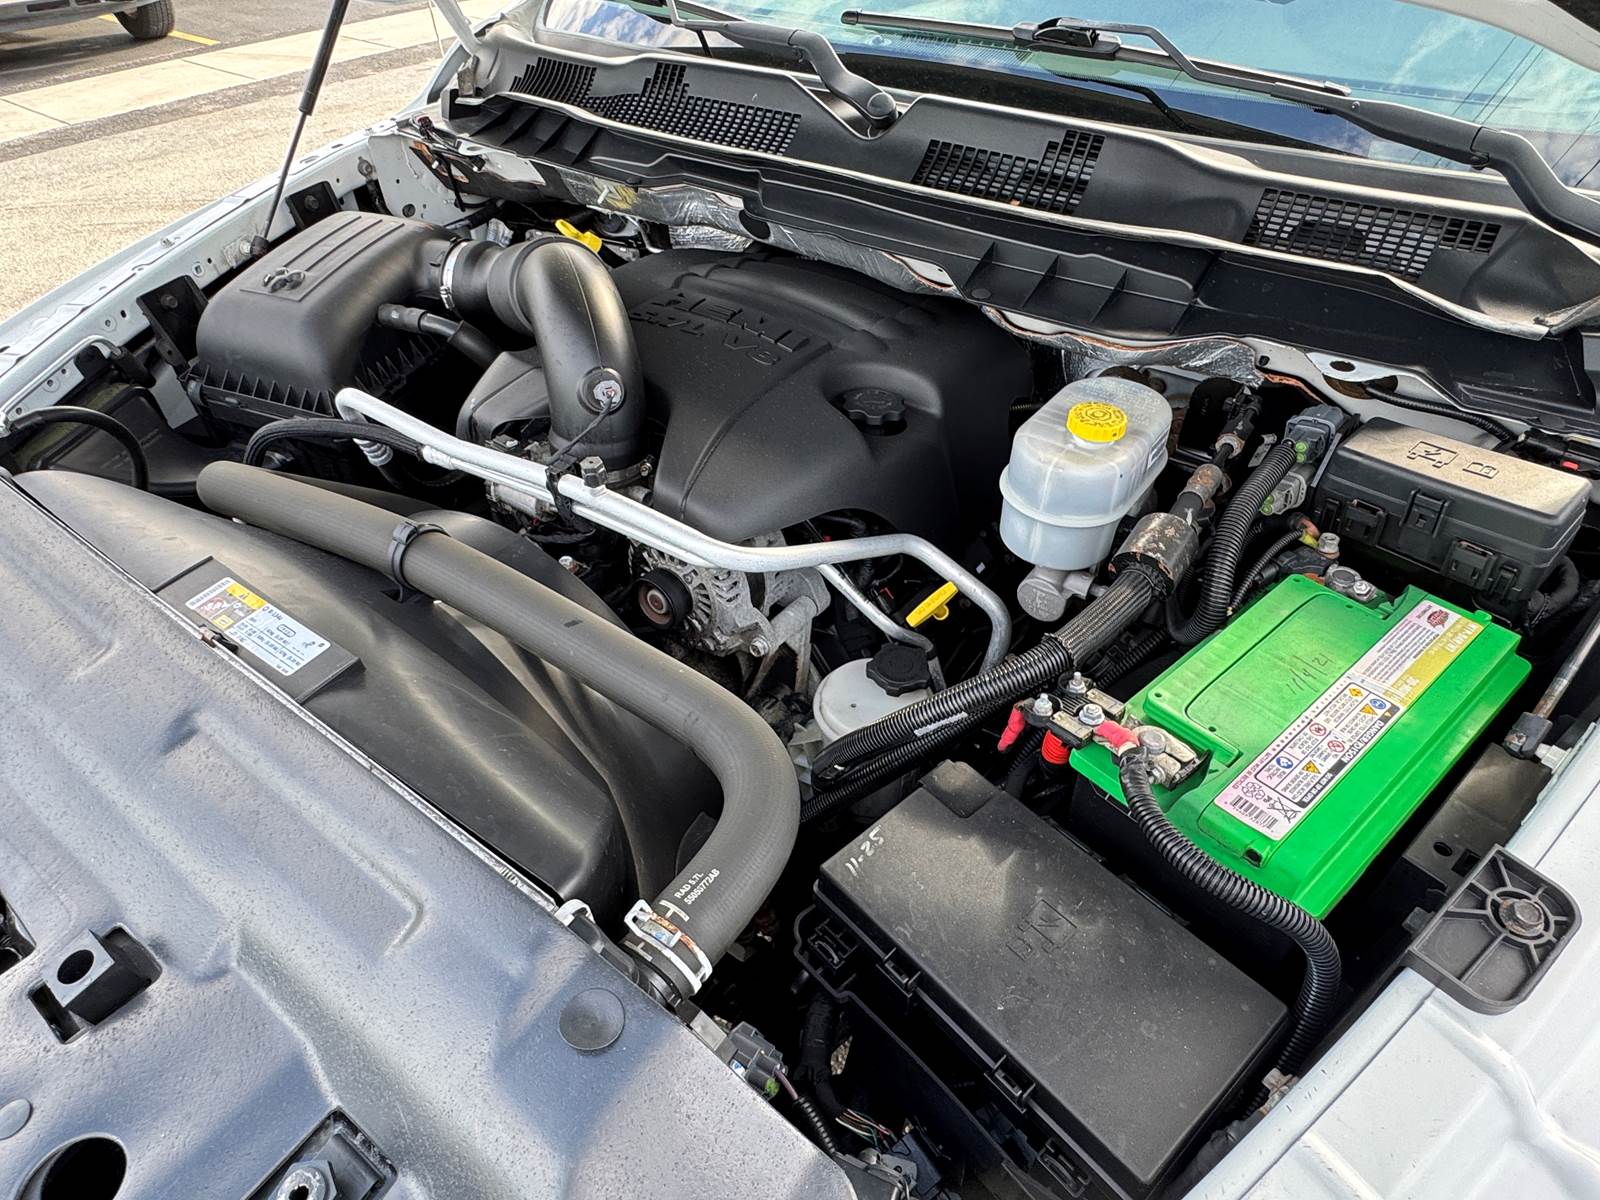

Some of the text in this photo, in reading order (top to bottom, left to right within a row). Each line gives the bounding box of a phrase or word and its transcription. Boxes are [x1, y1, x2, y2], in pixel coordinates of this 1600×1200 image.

[648, 293, 811, 353] HEMI
[674, 872, 704, 899] RAD 5.7L
